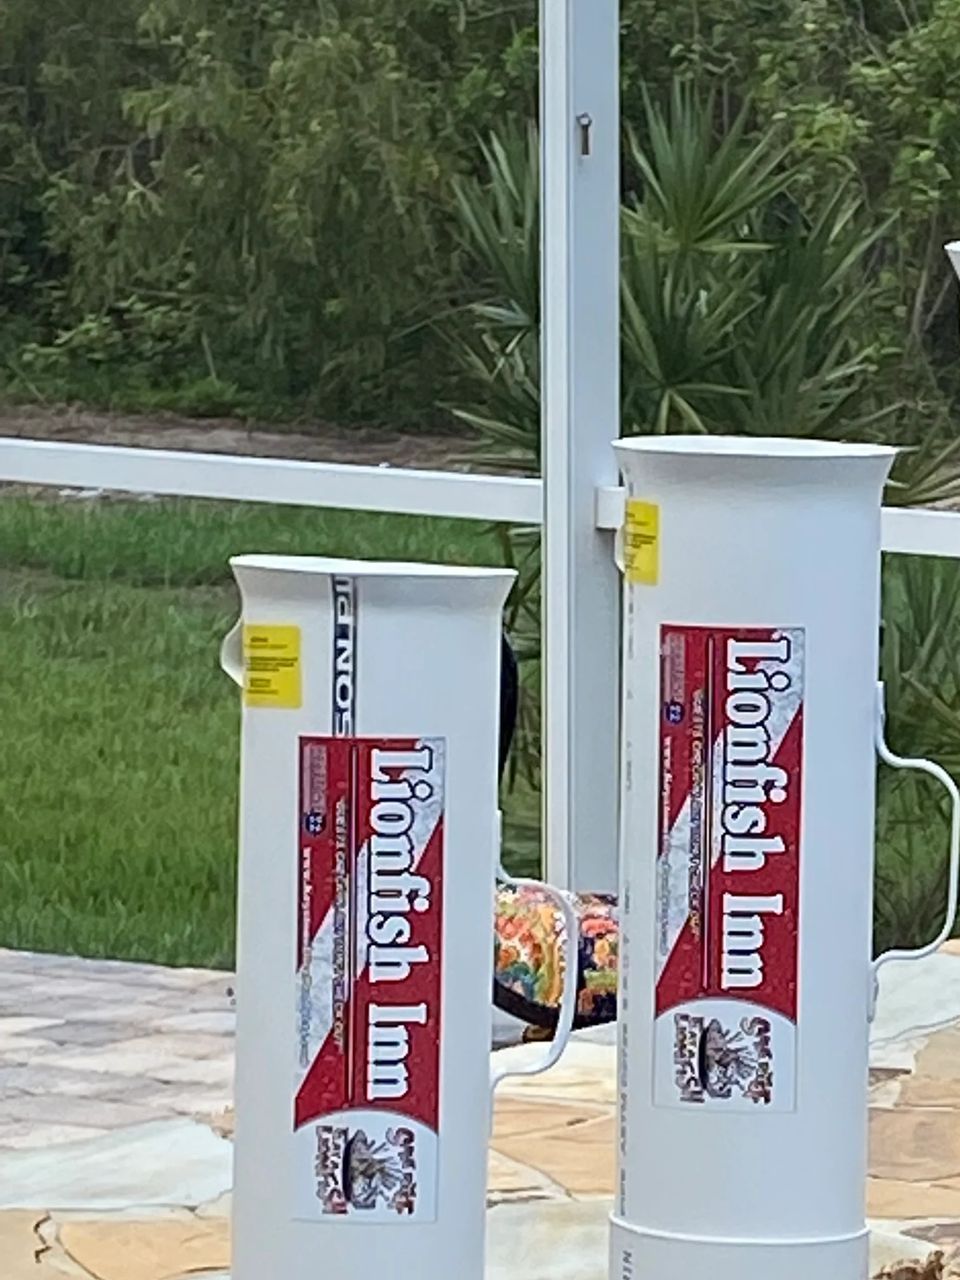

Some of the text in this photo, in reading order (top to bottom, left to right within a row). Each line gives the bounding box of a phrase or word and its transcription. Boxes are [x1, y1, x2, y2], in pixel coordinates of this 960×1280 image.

[366, 746, 434, 1101] Lionfish Inn
[720, 637, 791, 990] Lionfish Inn
